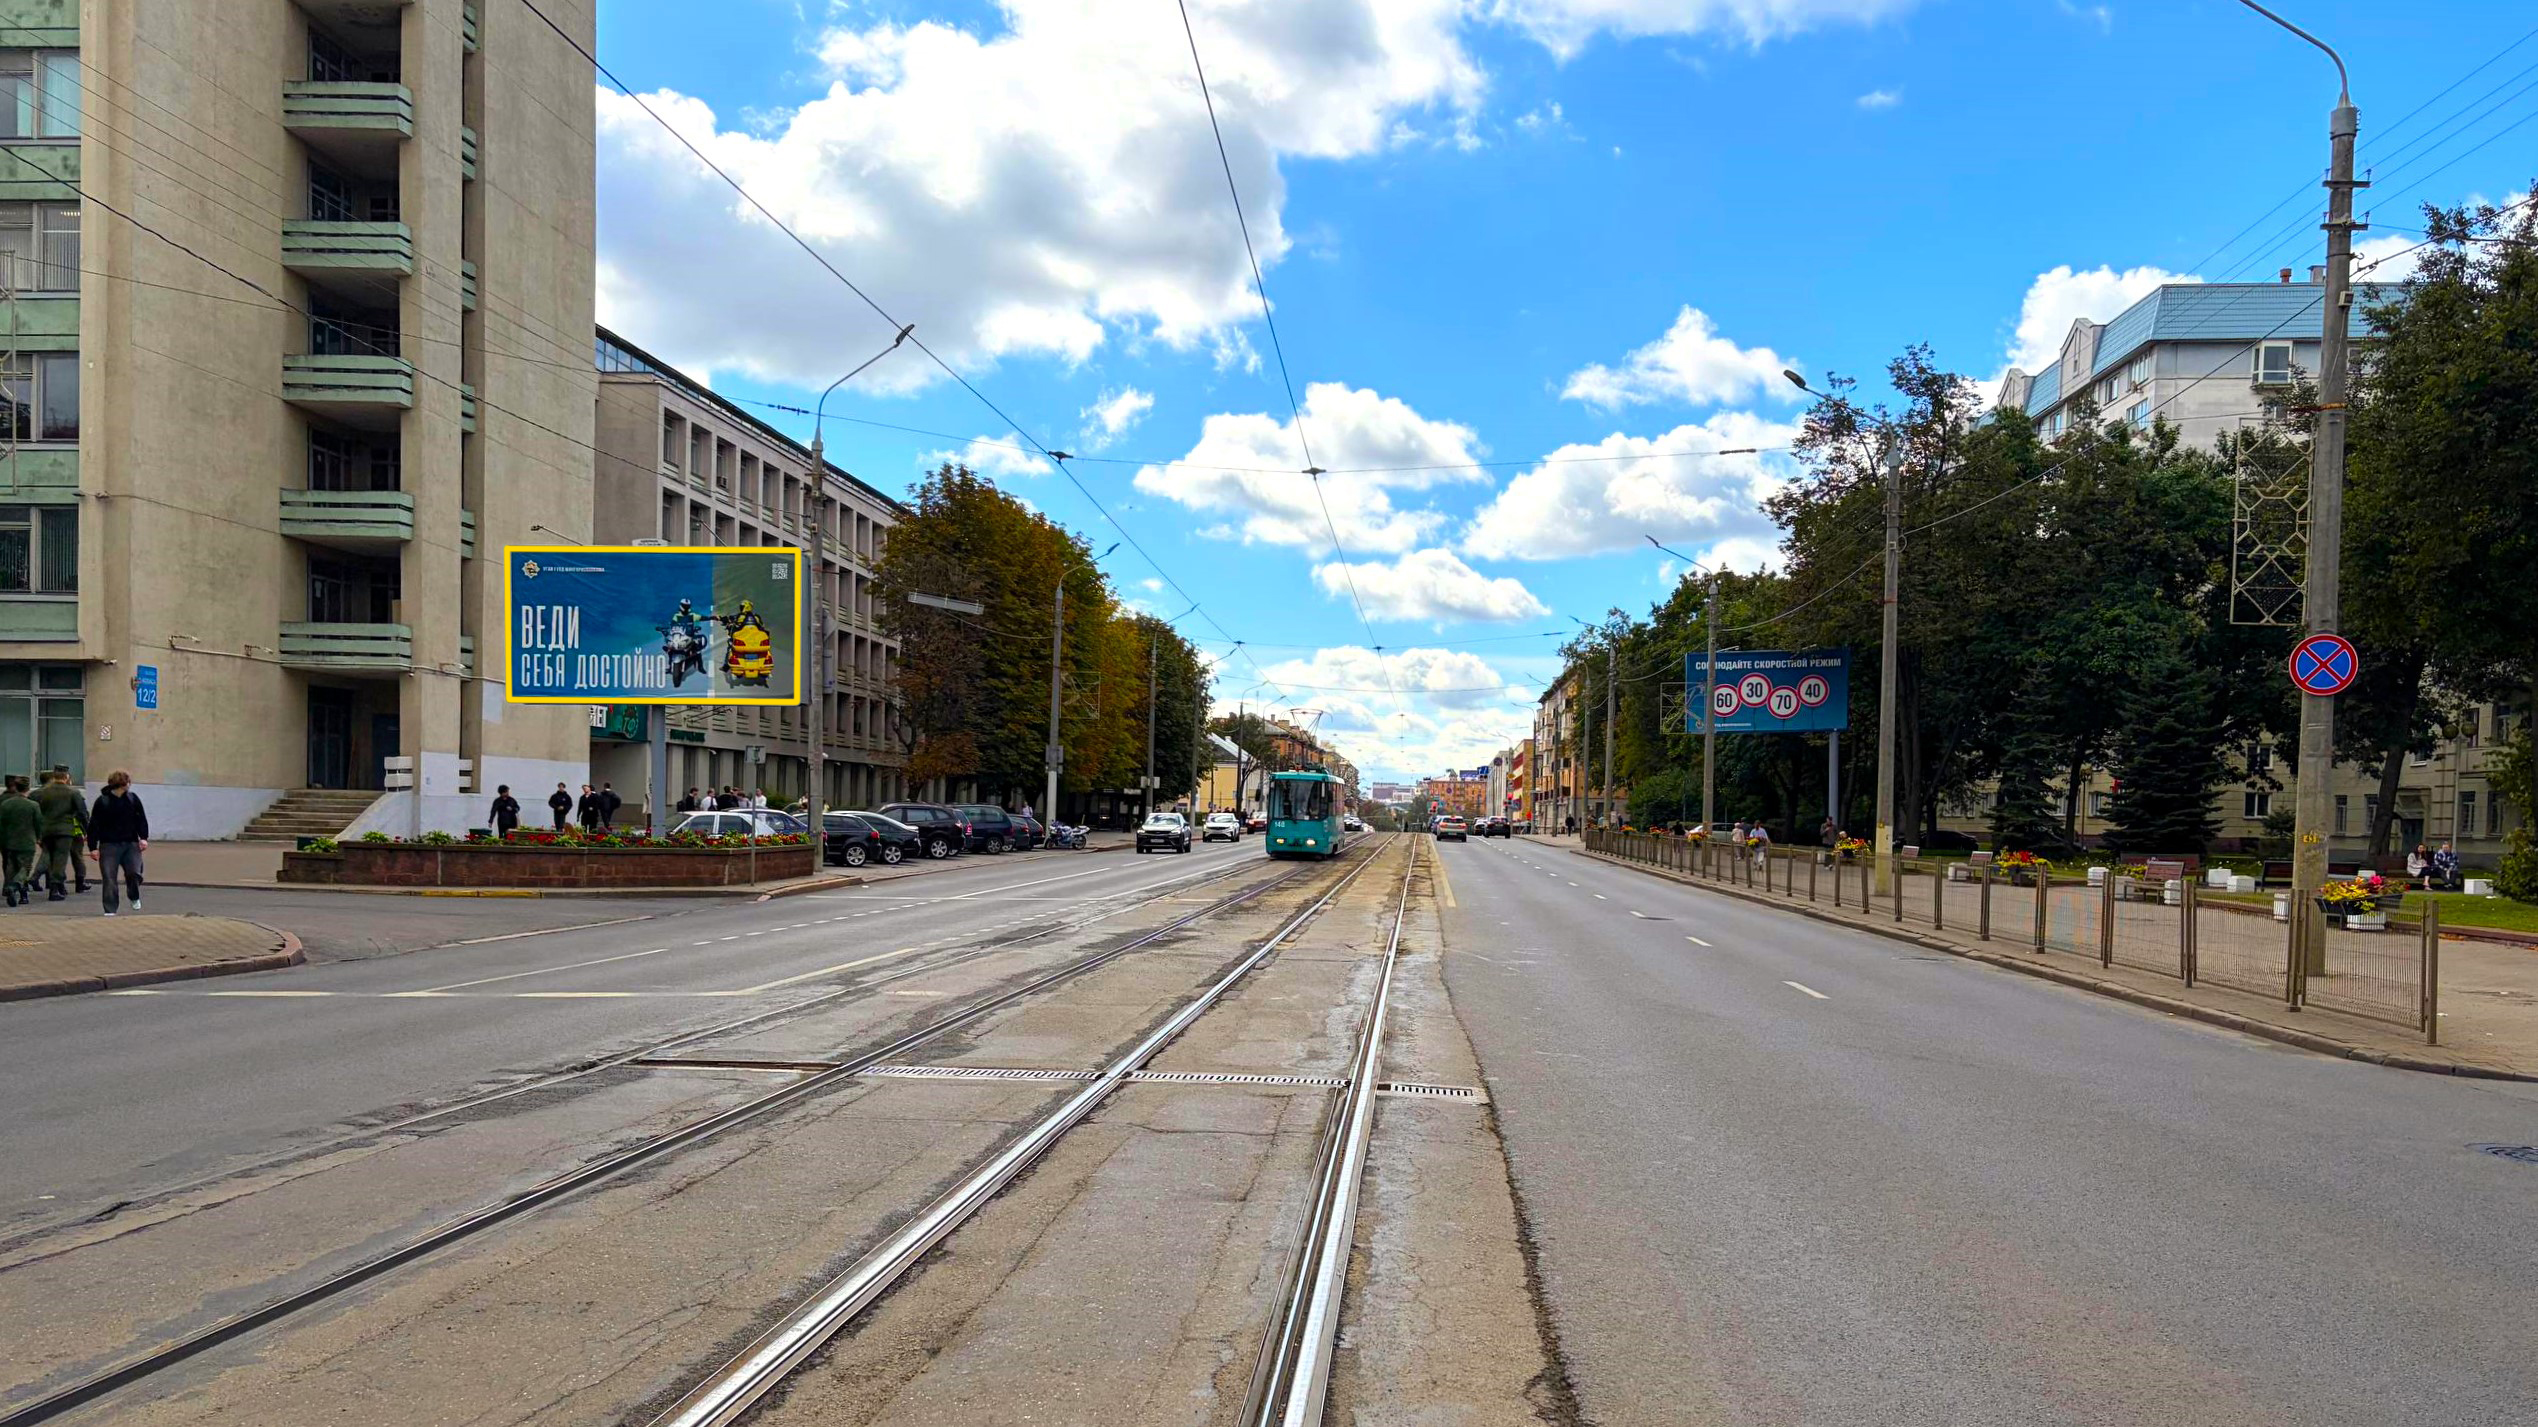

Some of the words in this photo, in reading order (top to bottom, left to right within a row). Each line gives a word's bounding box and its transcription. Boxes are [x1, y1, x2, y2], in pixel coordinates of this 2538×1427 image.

[521, 605, 579, 652] ВЕДИ
[521, 653, 565, 688] СЕБЯ
[574, 647, 667, 690] ДОСТОЙНО
[1695, 660, 1752, 671] СОЮДАЙТЕ
[1754, 658, 1808, 669] СКОРОСТНОЙ
[1810, 658, 1842, 668] РЕЖИМ
[137, 688, 156, 704] 12/2
[1746, 682, 1763, 698] 30
[1804, 683, 1821, 698] 40
[1716, 693, 1733, 708] 60
[1775, 694, 1792, 710] 70
